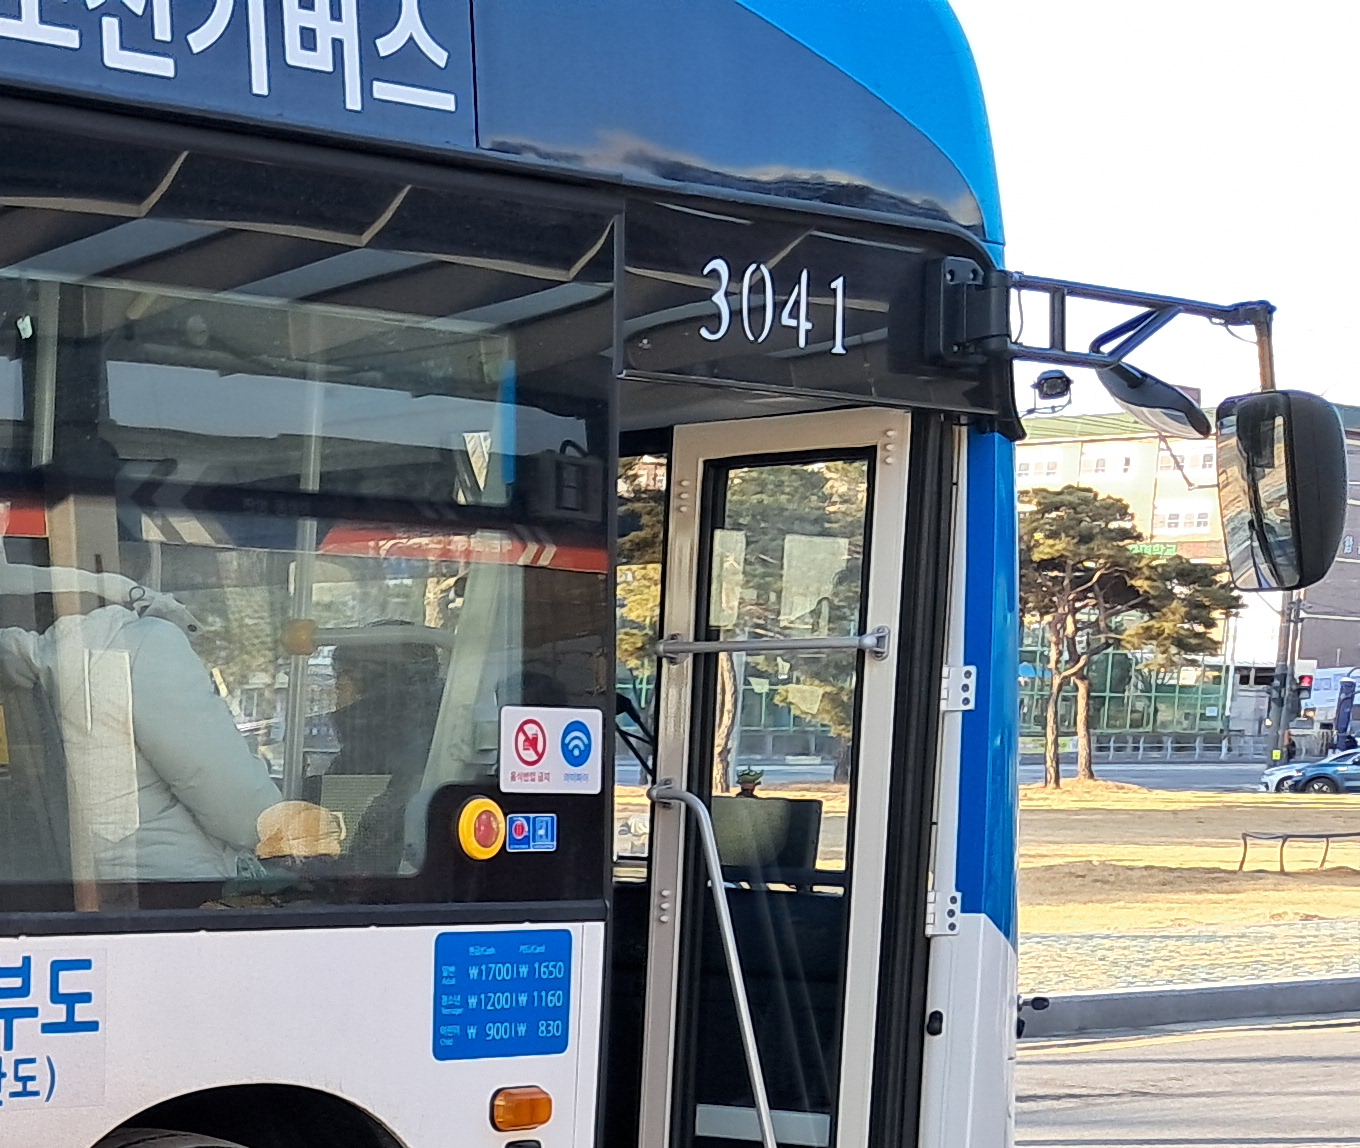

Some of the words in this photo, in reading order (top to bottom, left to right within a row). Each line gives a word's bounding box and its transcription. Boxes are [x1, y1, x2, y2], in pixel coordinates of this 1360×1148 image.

[699, 258, 848, 355] 3041
[534, 961, 564, 979] 1650
[533, 990, 563, 1008] 1160
[486, 1022, 510, 1041] 900
[538, 1019, 562, 1037] 830
